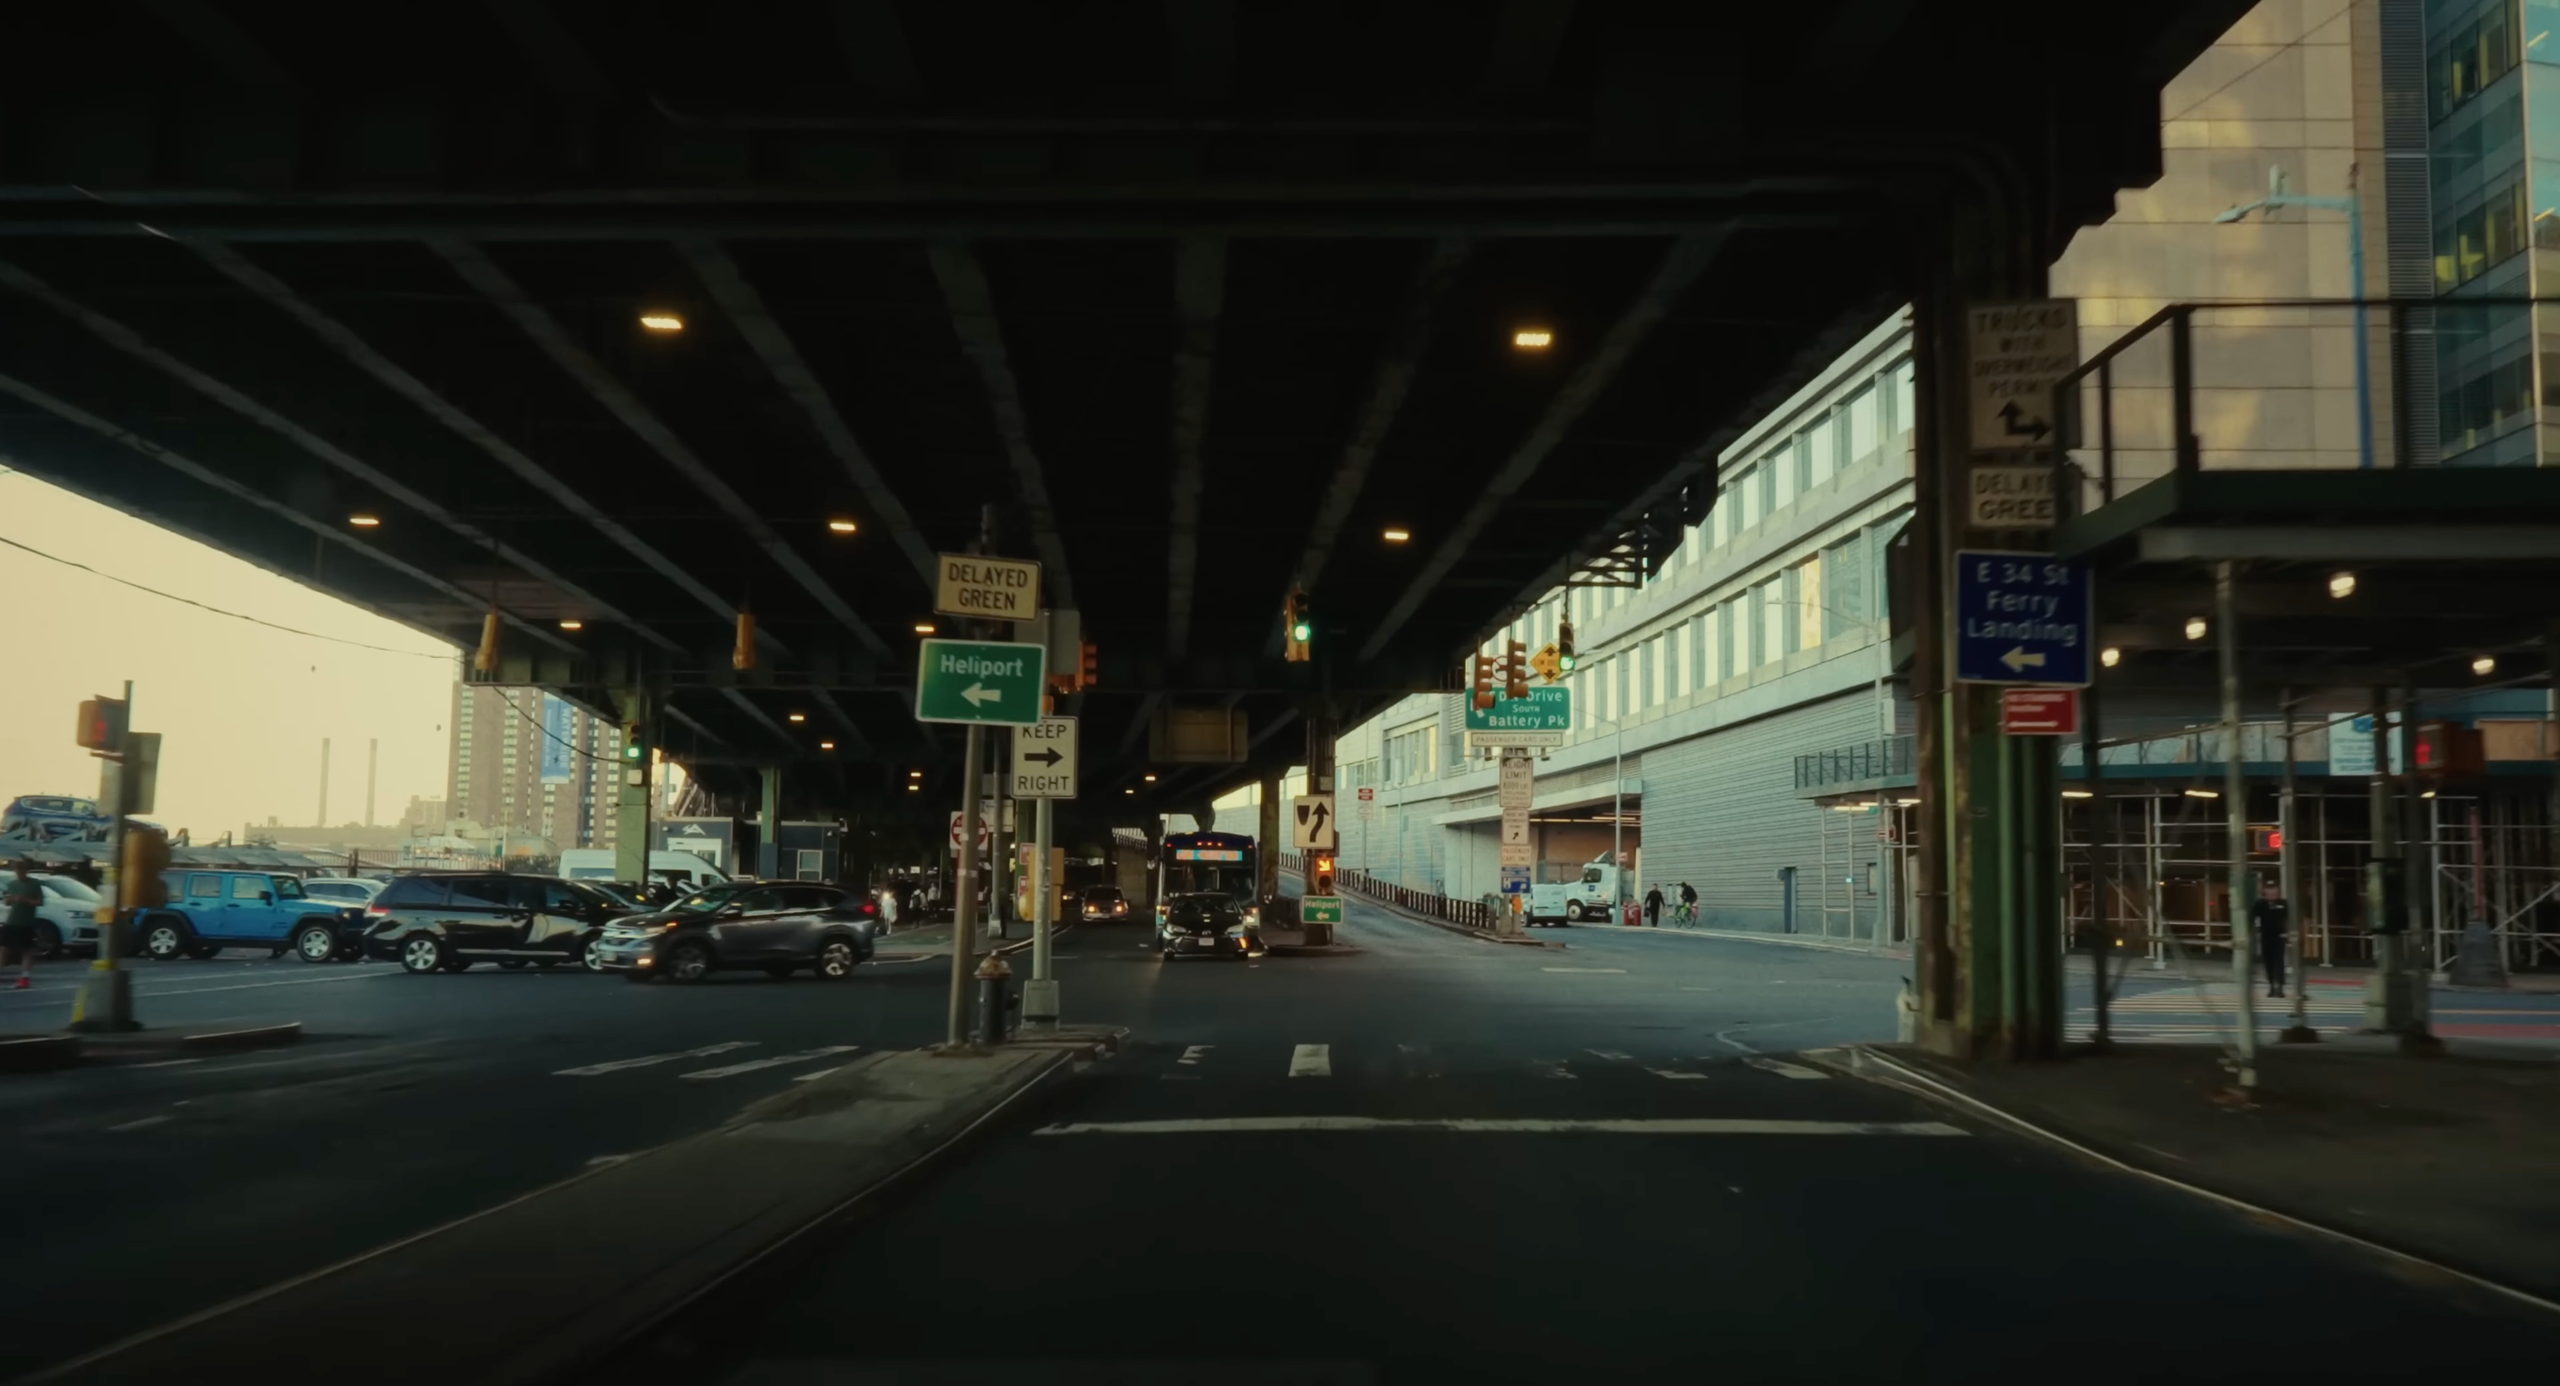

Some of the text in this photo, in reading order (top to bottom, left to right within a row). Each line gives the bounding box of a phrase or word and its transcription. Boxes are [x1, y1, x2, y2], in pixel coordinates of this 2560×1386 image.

[1976, 307, 2067, 333] TRUCKS
[1979, 499, 2054, 519] GREE
[948, 563, 1028, 588] DELAYED
[1977, 561, 2070, 585] E 34 St
[958, 588, 1015, 611] GREEN
[1987, 590, 2059, 623] Ferry
[1967, 617, 2078, 647] Landing
[940, 654, 1023, 679] Heliport
[1022, 724, 1067, 738] KEEP
[1488, 715, 1565, 728] Battery Pk
[1018, 776, 1070, 790] RIGHT
[1505, 771, 1527, 779] LIMIT
[1305, 900, 1340, 910] Heliport
